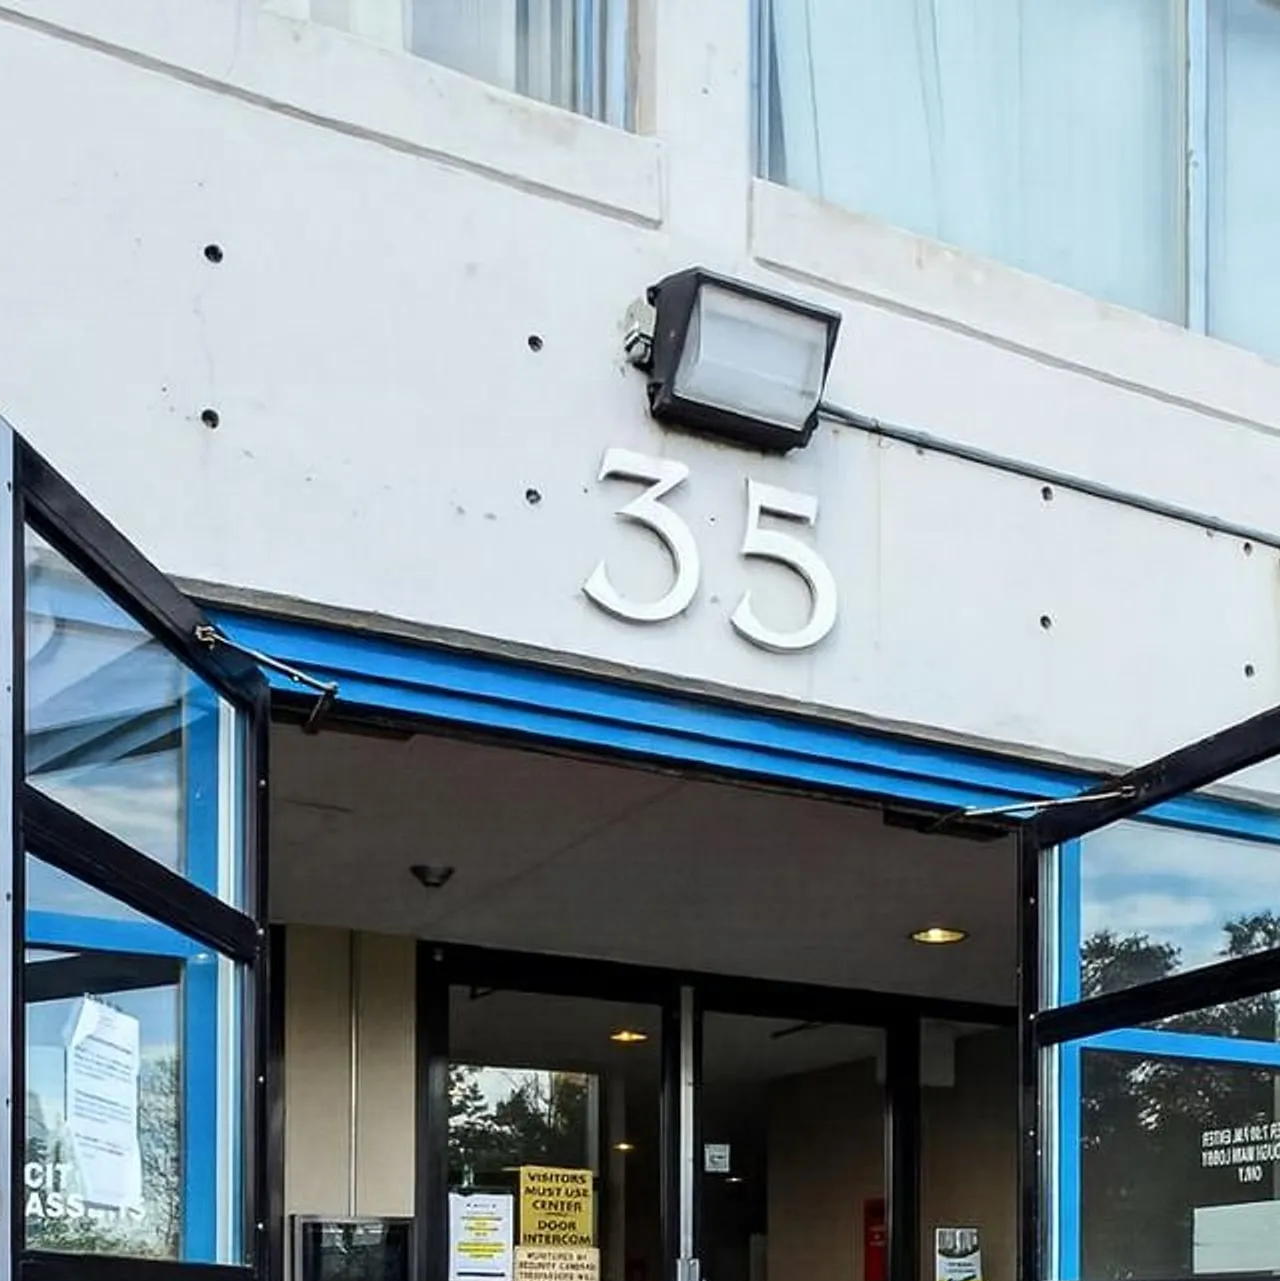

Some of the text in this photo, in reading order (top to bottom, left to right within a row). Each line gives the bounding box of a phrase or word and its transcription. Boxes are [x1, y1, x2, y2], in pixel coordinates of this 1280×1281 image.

[581, 447, 838, 654] 35
[527, 1172, 587, 1184] VISITORS
[524, 1186, 589, 1198] MUST USE
[532, 1200, 582, 1212] CENTER
[538, 1220, 577, 1231] DOOR
[523, 1233, 591, 1245] INTERCOM
